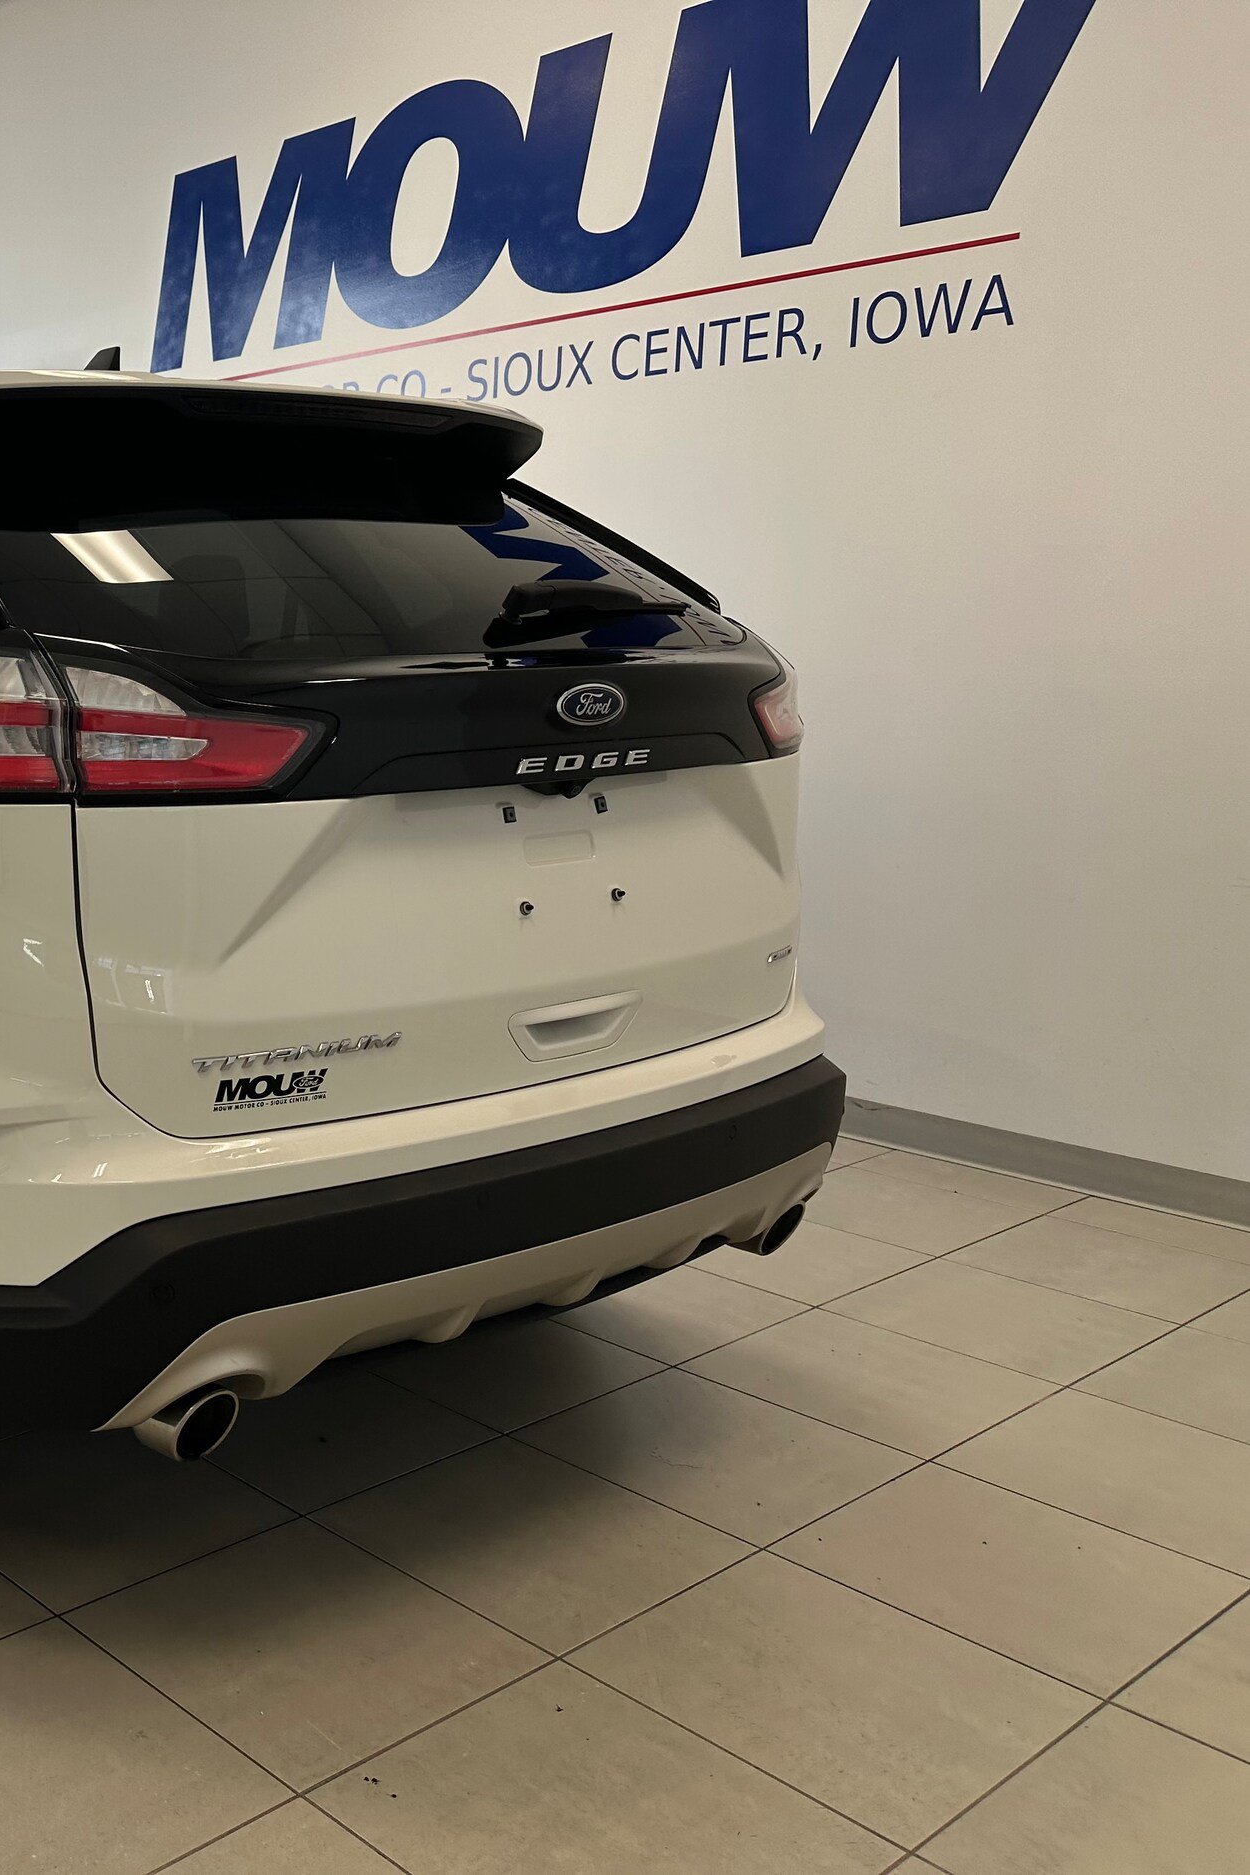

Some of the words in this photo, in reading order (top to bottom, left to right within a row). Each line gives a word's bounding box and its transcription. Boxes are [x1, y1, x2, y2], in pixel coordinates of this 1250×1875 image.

[151, 0, 1097, 371] MOUW
[466, 340, 594, 401] SIOUX
[611, 307, 823, 380] CENTER,
[849, 273, 1015, 348] IOWA
[575, 692, 613, 716] Ford
[515, 749, 651, 776] EDGE
[191, 1031, 403, 1073] TITANIUM
[270, 1098, 288, 1106] SIOUX
